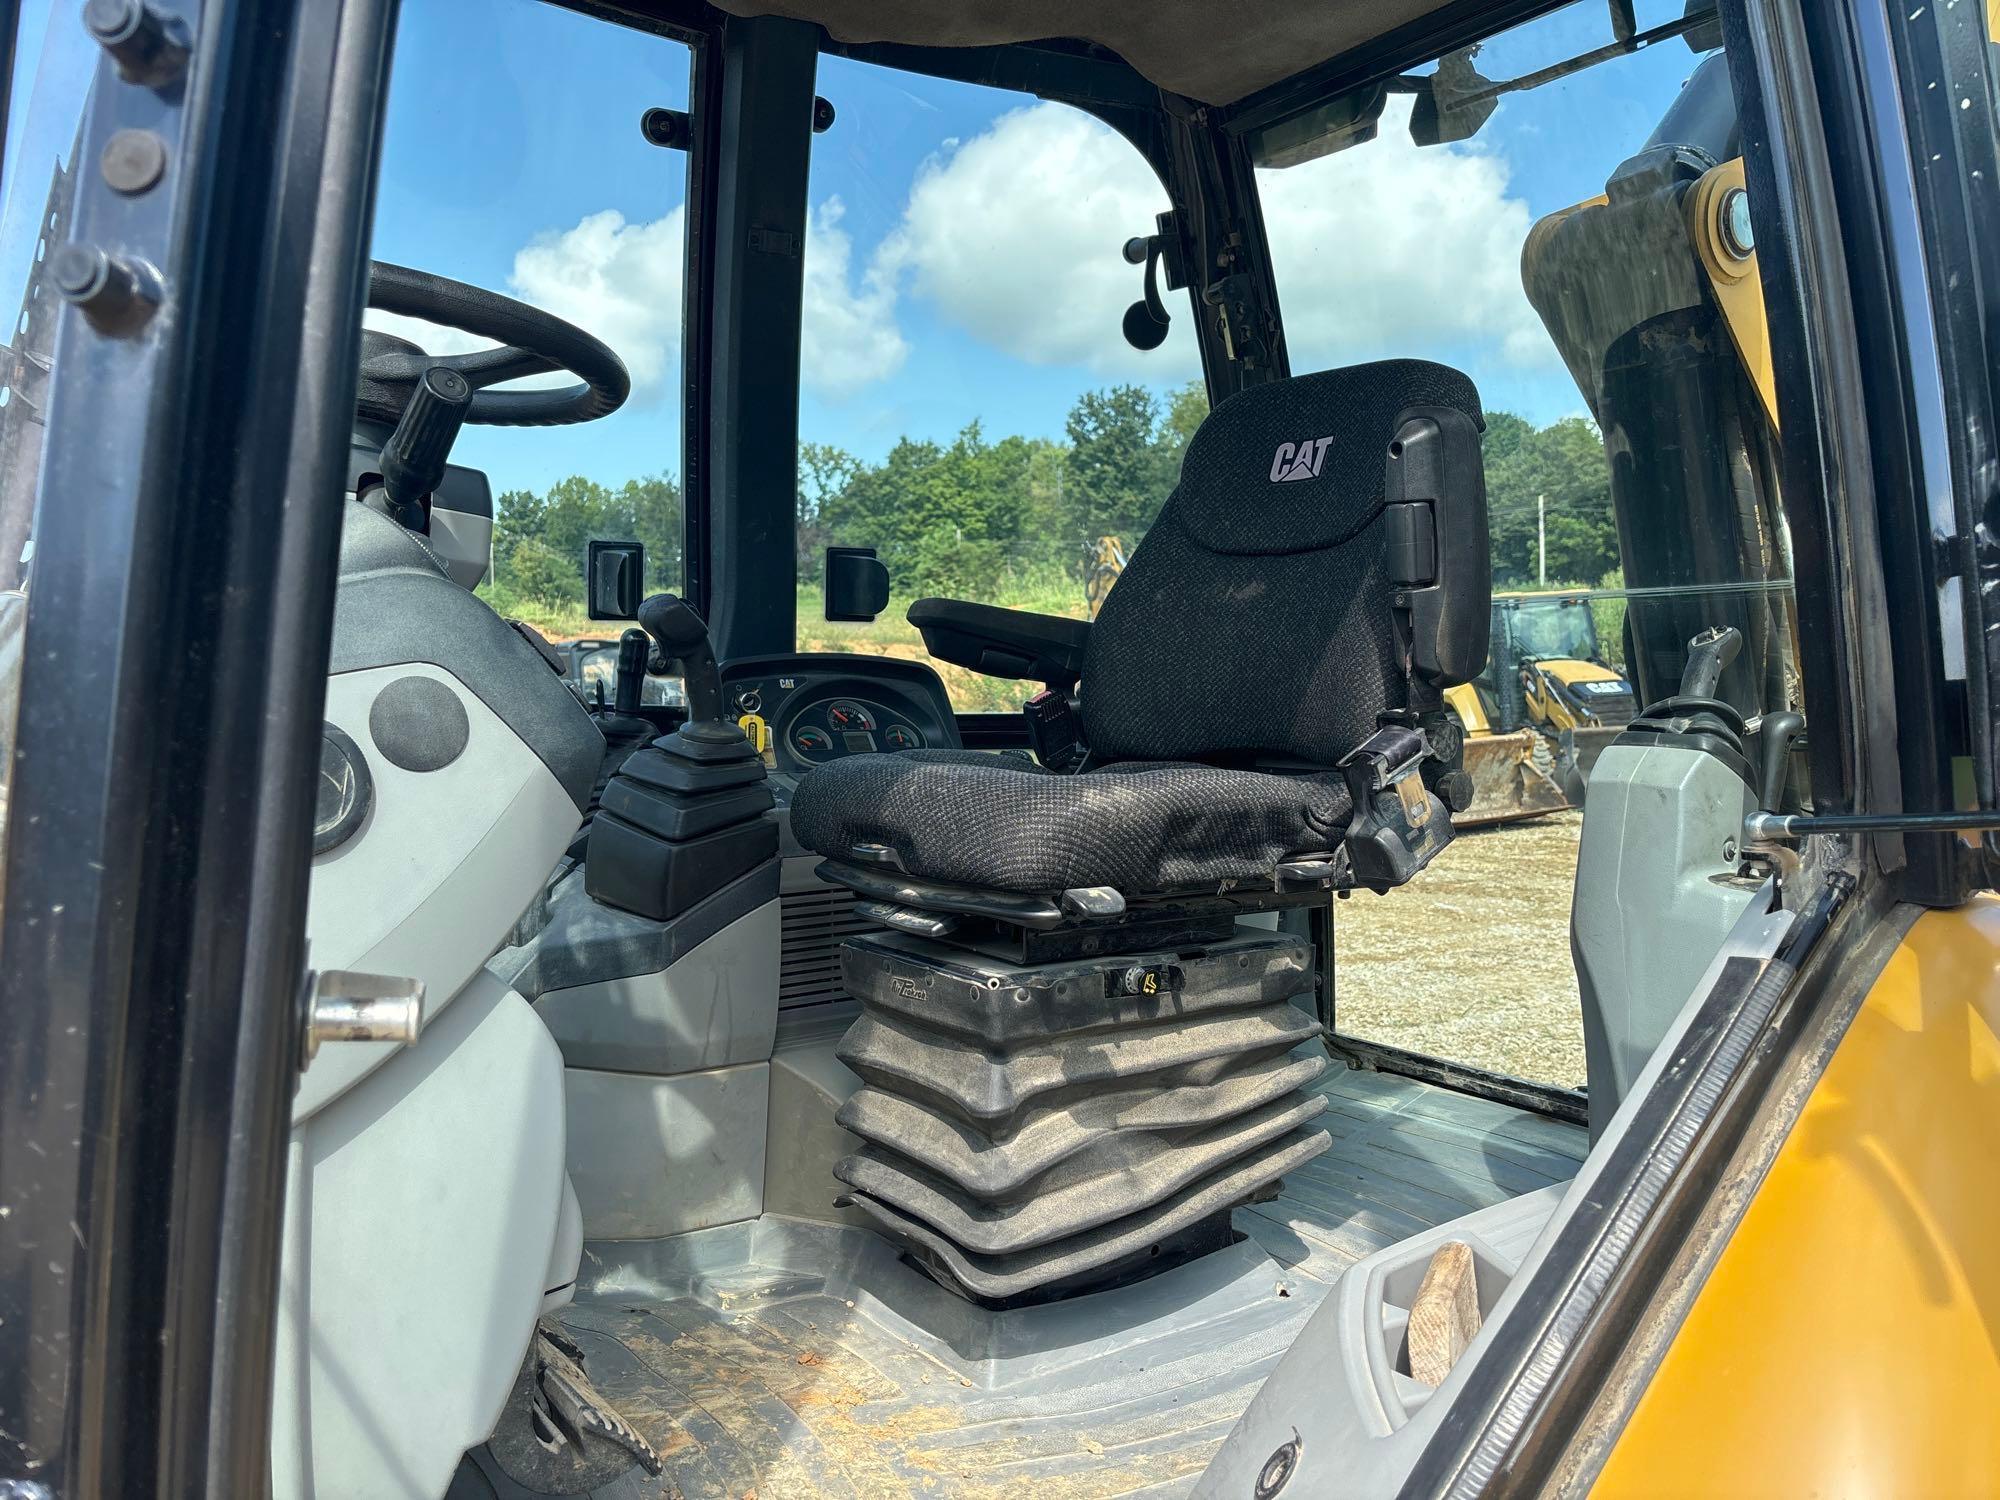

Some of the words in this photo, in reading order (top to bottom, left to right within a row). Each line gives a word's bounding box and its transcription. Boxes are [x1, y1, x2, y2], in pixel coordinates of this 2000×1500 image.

[1269, 435, 1334, 483] CAT
[779, 678, 795, 689] CAT
[1585, 681, 1624, 693] CAT
